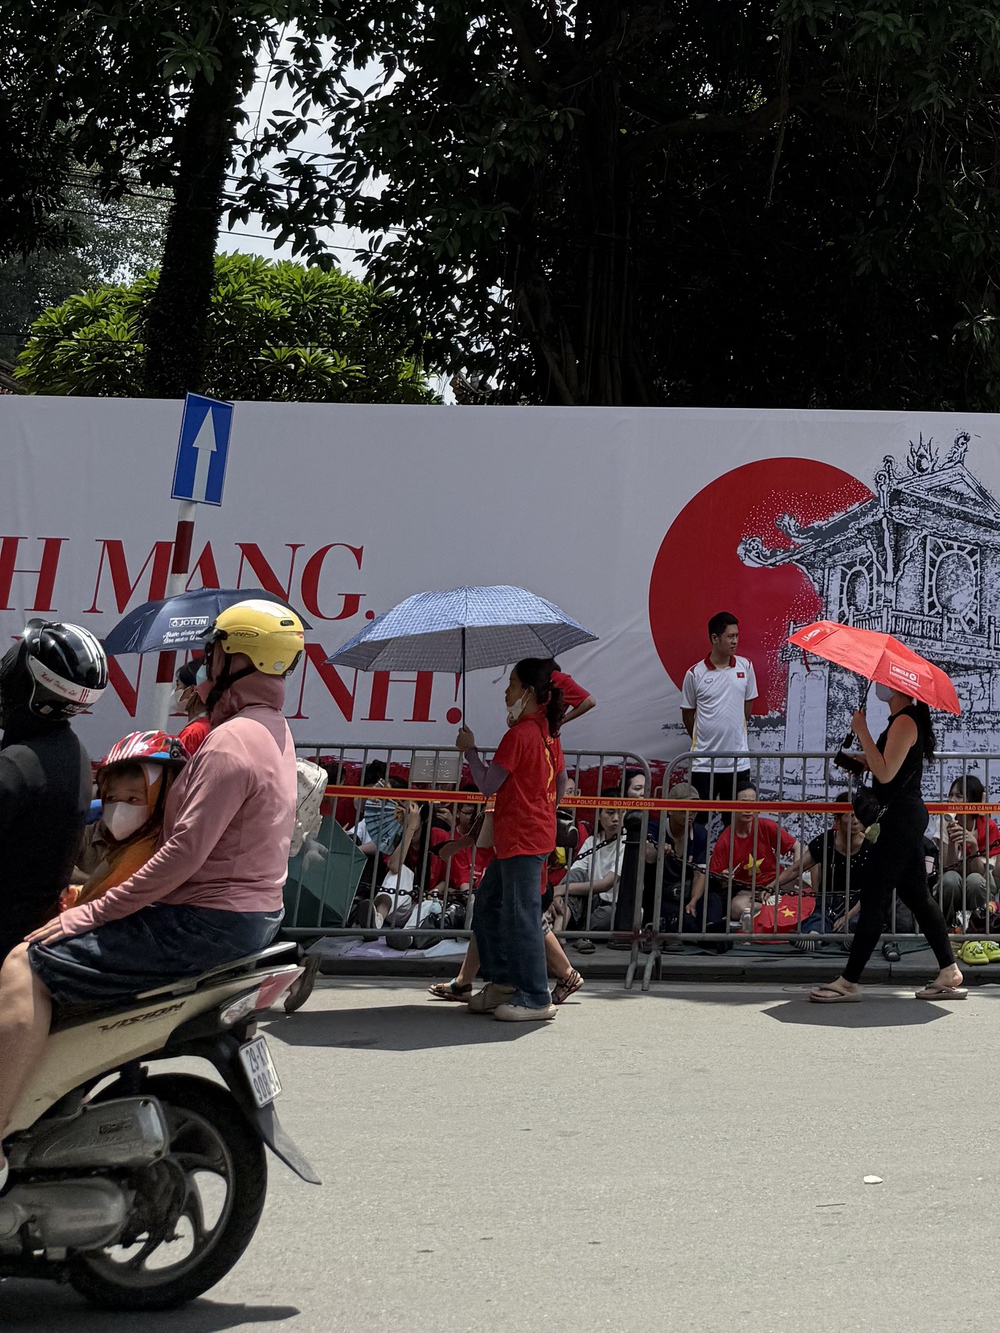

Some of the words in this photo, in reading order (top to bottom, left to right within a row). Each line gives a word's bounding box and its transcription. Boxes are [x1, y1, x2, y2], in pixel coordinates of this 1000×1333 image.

[178, 618, 207, 627] JOTUN
[576, 798, 597, 806] POLICE
[636, 800, 655, 808] CROSS
[98, 1001, 186, 1033] VISION
